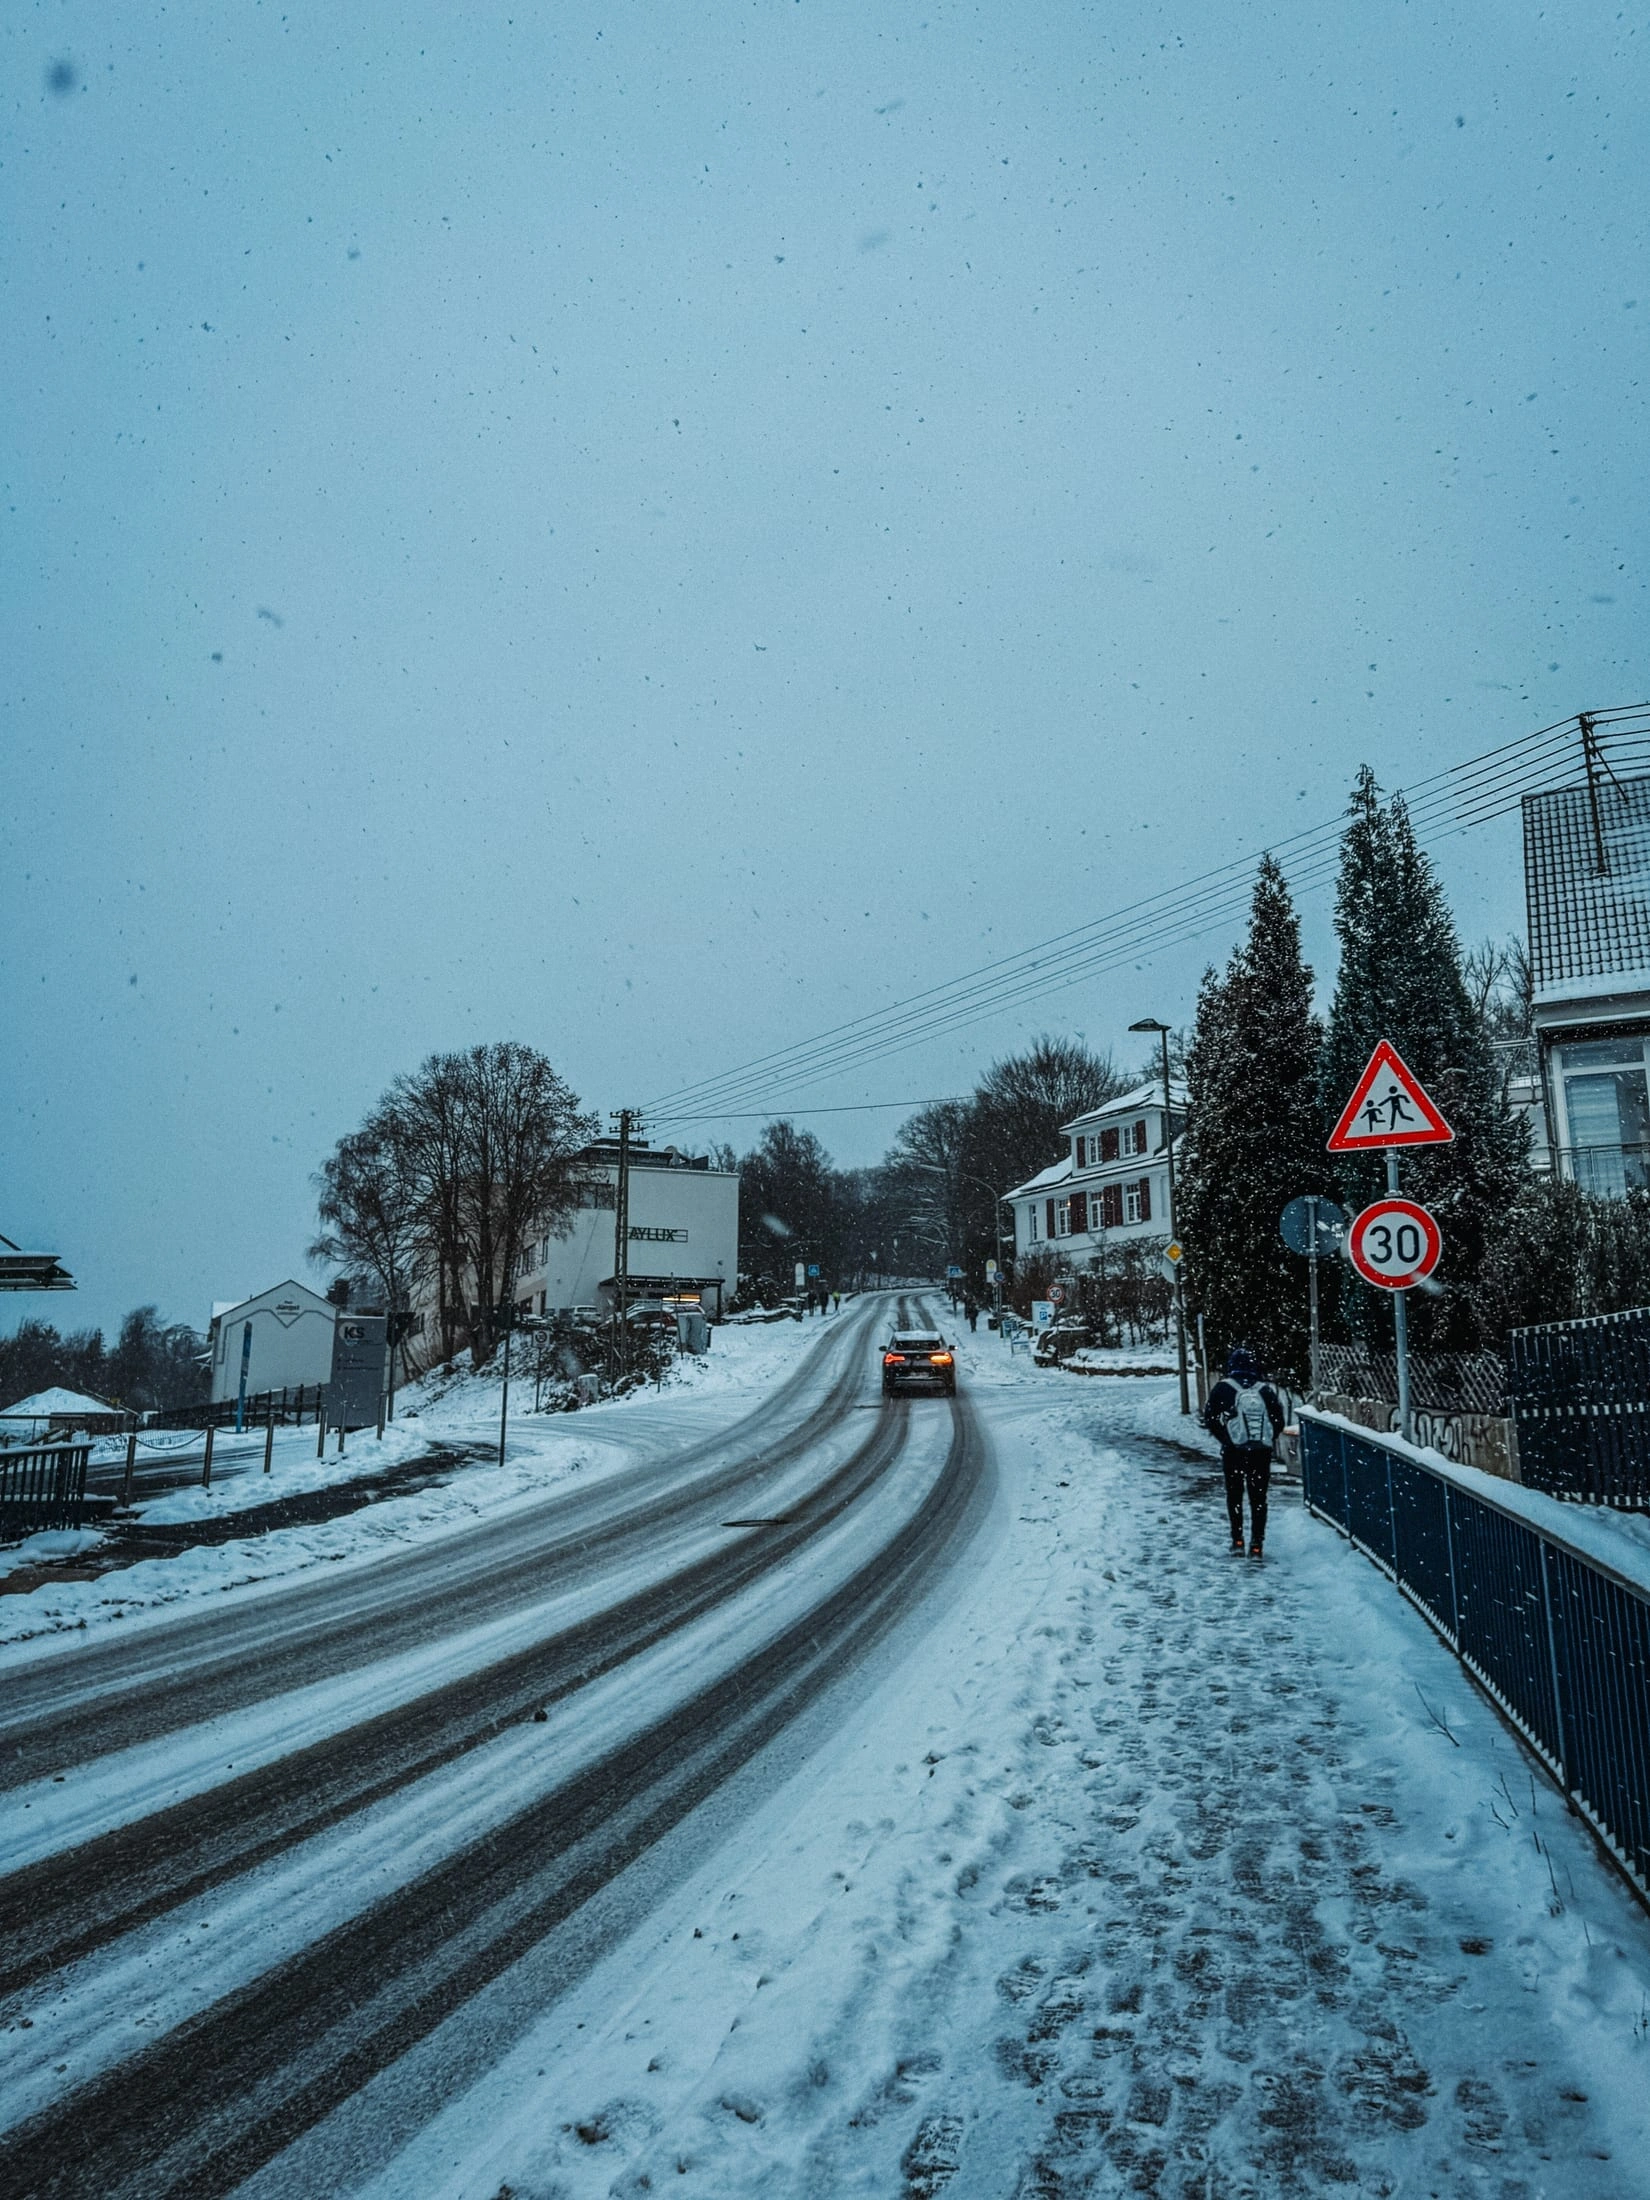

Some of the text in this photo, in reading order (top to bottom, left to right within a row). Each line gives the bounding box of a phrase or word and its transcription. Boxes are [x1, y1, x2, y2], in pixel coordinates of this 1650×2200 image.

[1369, 1224, 1420, 1264] 30
[1051, 1289, 1060, 1298] 30
[344, 1326, 365, 1339] KS
